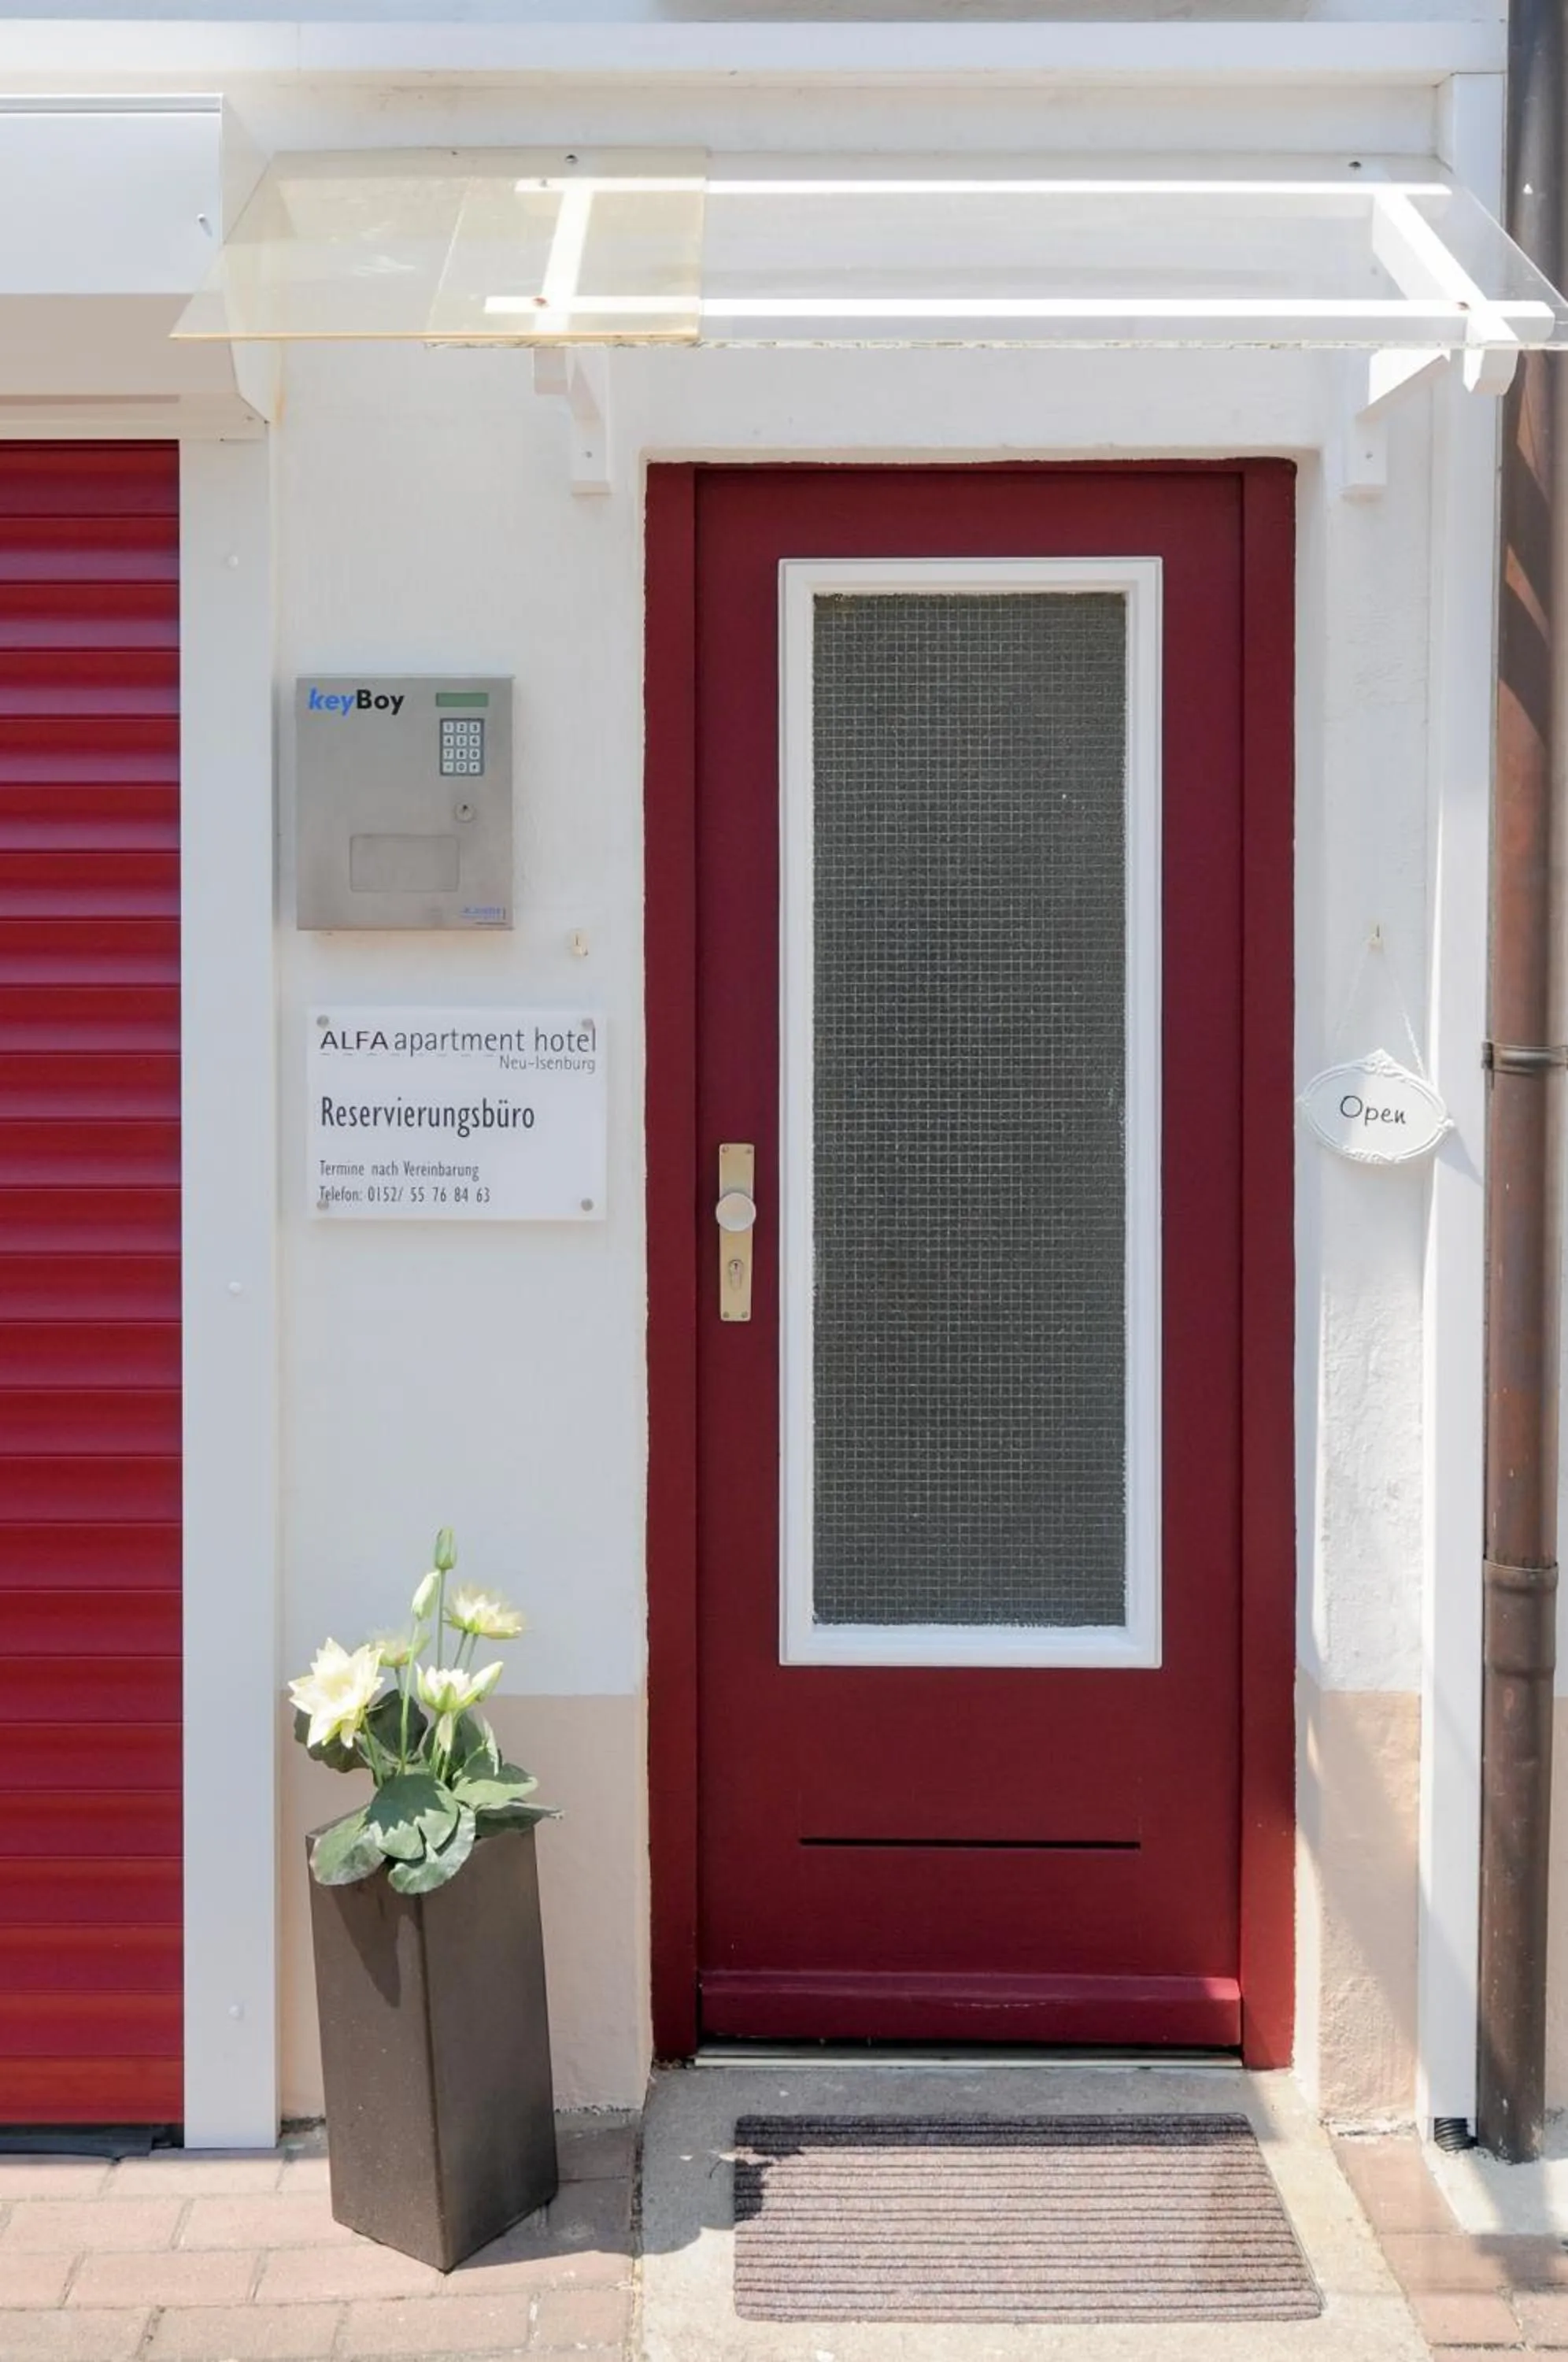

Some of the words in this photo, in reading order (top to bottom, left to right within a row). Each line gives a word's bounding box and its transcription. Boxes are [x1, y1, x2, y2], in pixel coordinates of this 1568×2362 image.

[309, 687, 405, 715] keyBoy
[320, 1031, 389, 1050] ALFA
[394, 1028, 525, 1057] apartment
[534, 1026, 597, 1053] hotel
[499, 1055, 596, 1075] Neu-Isenburg
[321, 1096, 535, 1138] Reservierungsbüro
[1339, 1095, 1407, 1126] Open
[320, 1160, 364, 1176] Termine
[371, 1160, 398, 1176] nach
[403, 1161, 479, 1182] Vereinbarung
[320, 1186, 362, 1201] Telefon:
[368, 1187, 404, 1202] 0152/
[411, 1187, 425, 1202] 55
[432, 1187, 446, 1202] 76
[454, 1187, 468, 1202] 84
[476, 1187, 490, 1202] 63
